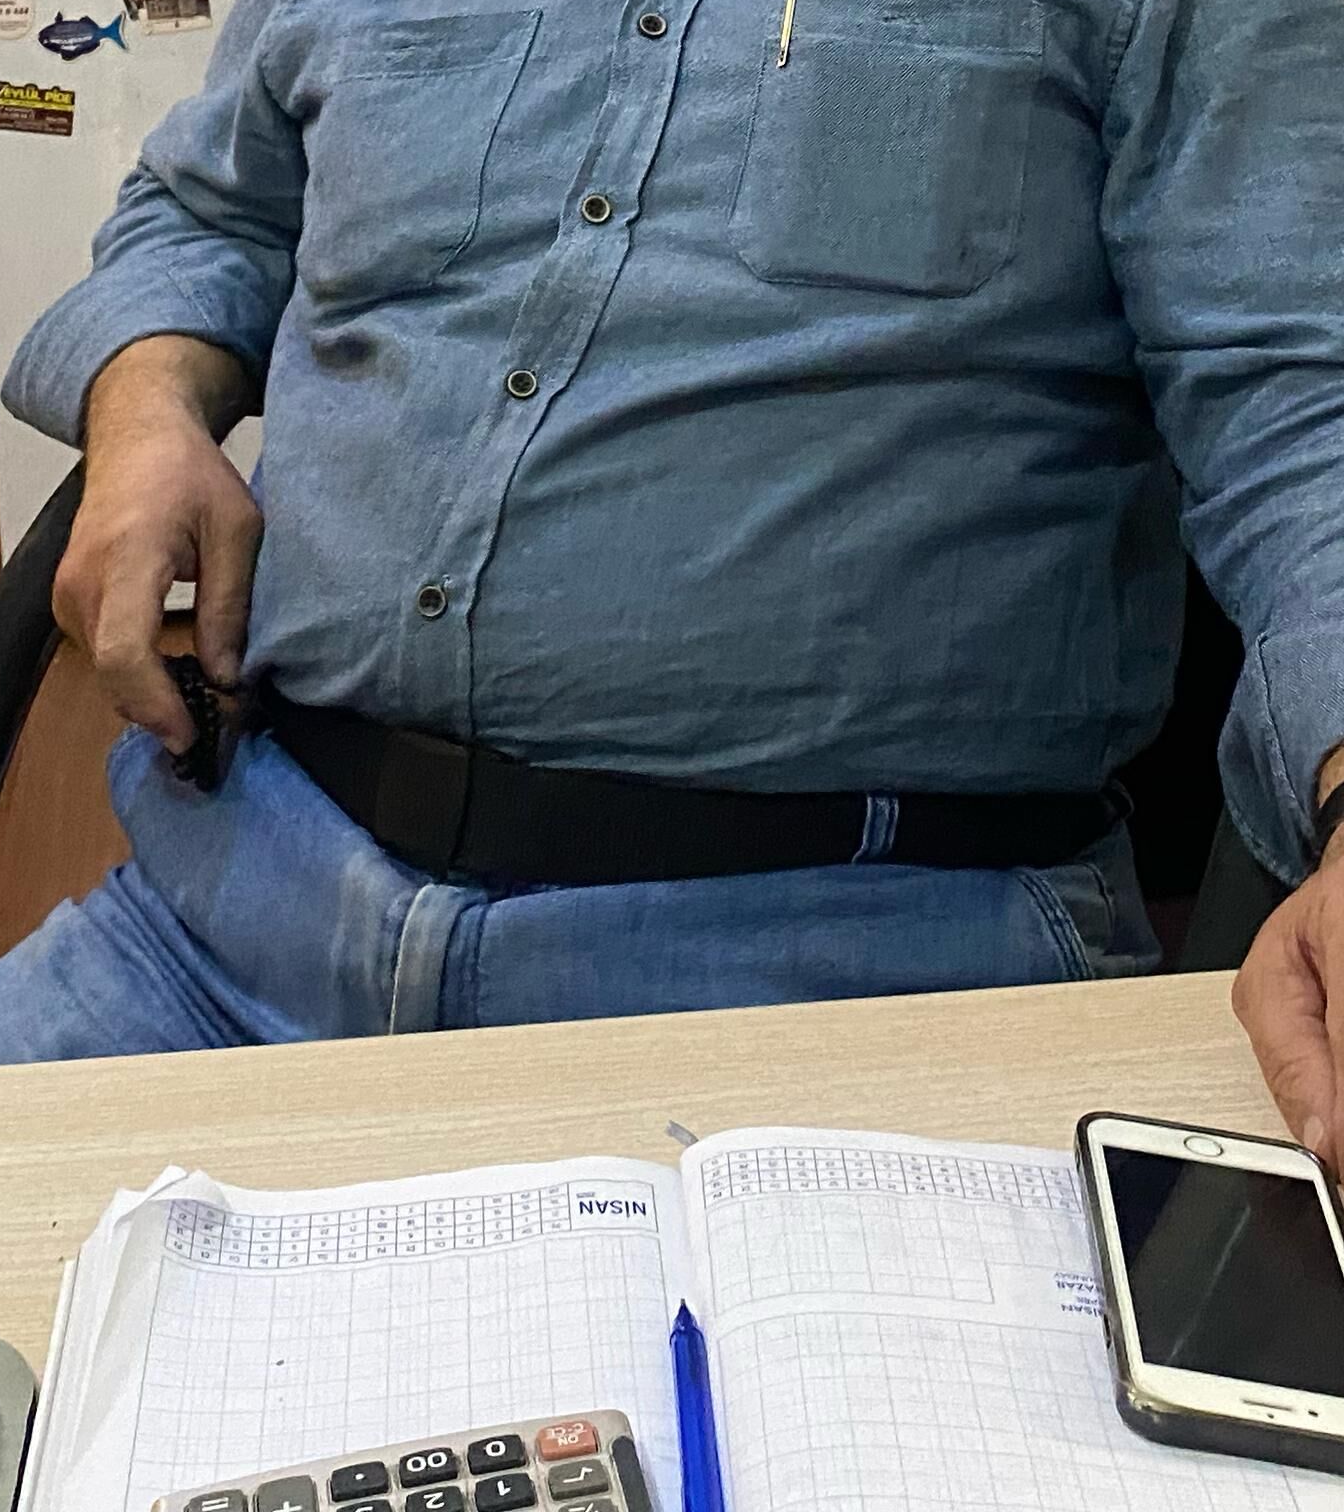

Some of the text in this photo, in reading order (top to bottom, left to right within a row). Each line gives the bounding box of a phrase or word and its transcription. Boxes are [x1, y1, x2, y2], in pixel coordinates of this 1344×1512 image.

[579, 1200, 647, 1219] NİSAN
[484, 1439, 507, 1458] 0
[557, 1434, 580, 1448] ON
[406, 1451, 449, 1473] 00
[496, 1480, 512, 1498] 1
[423, 1492, 447, 1510] 2
